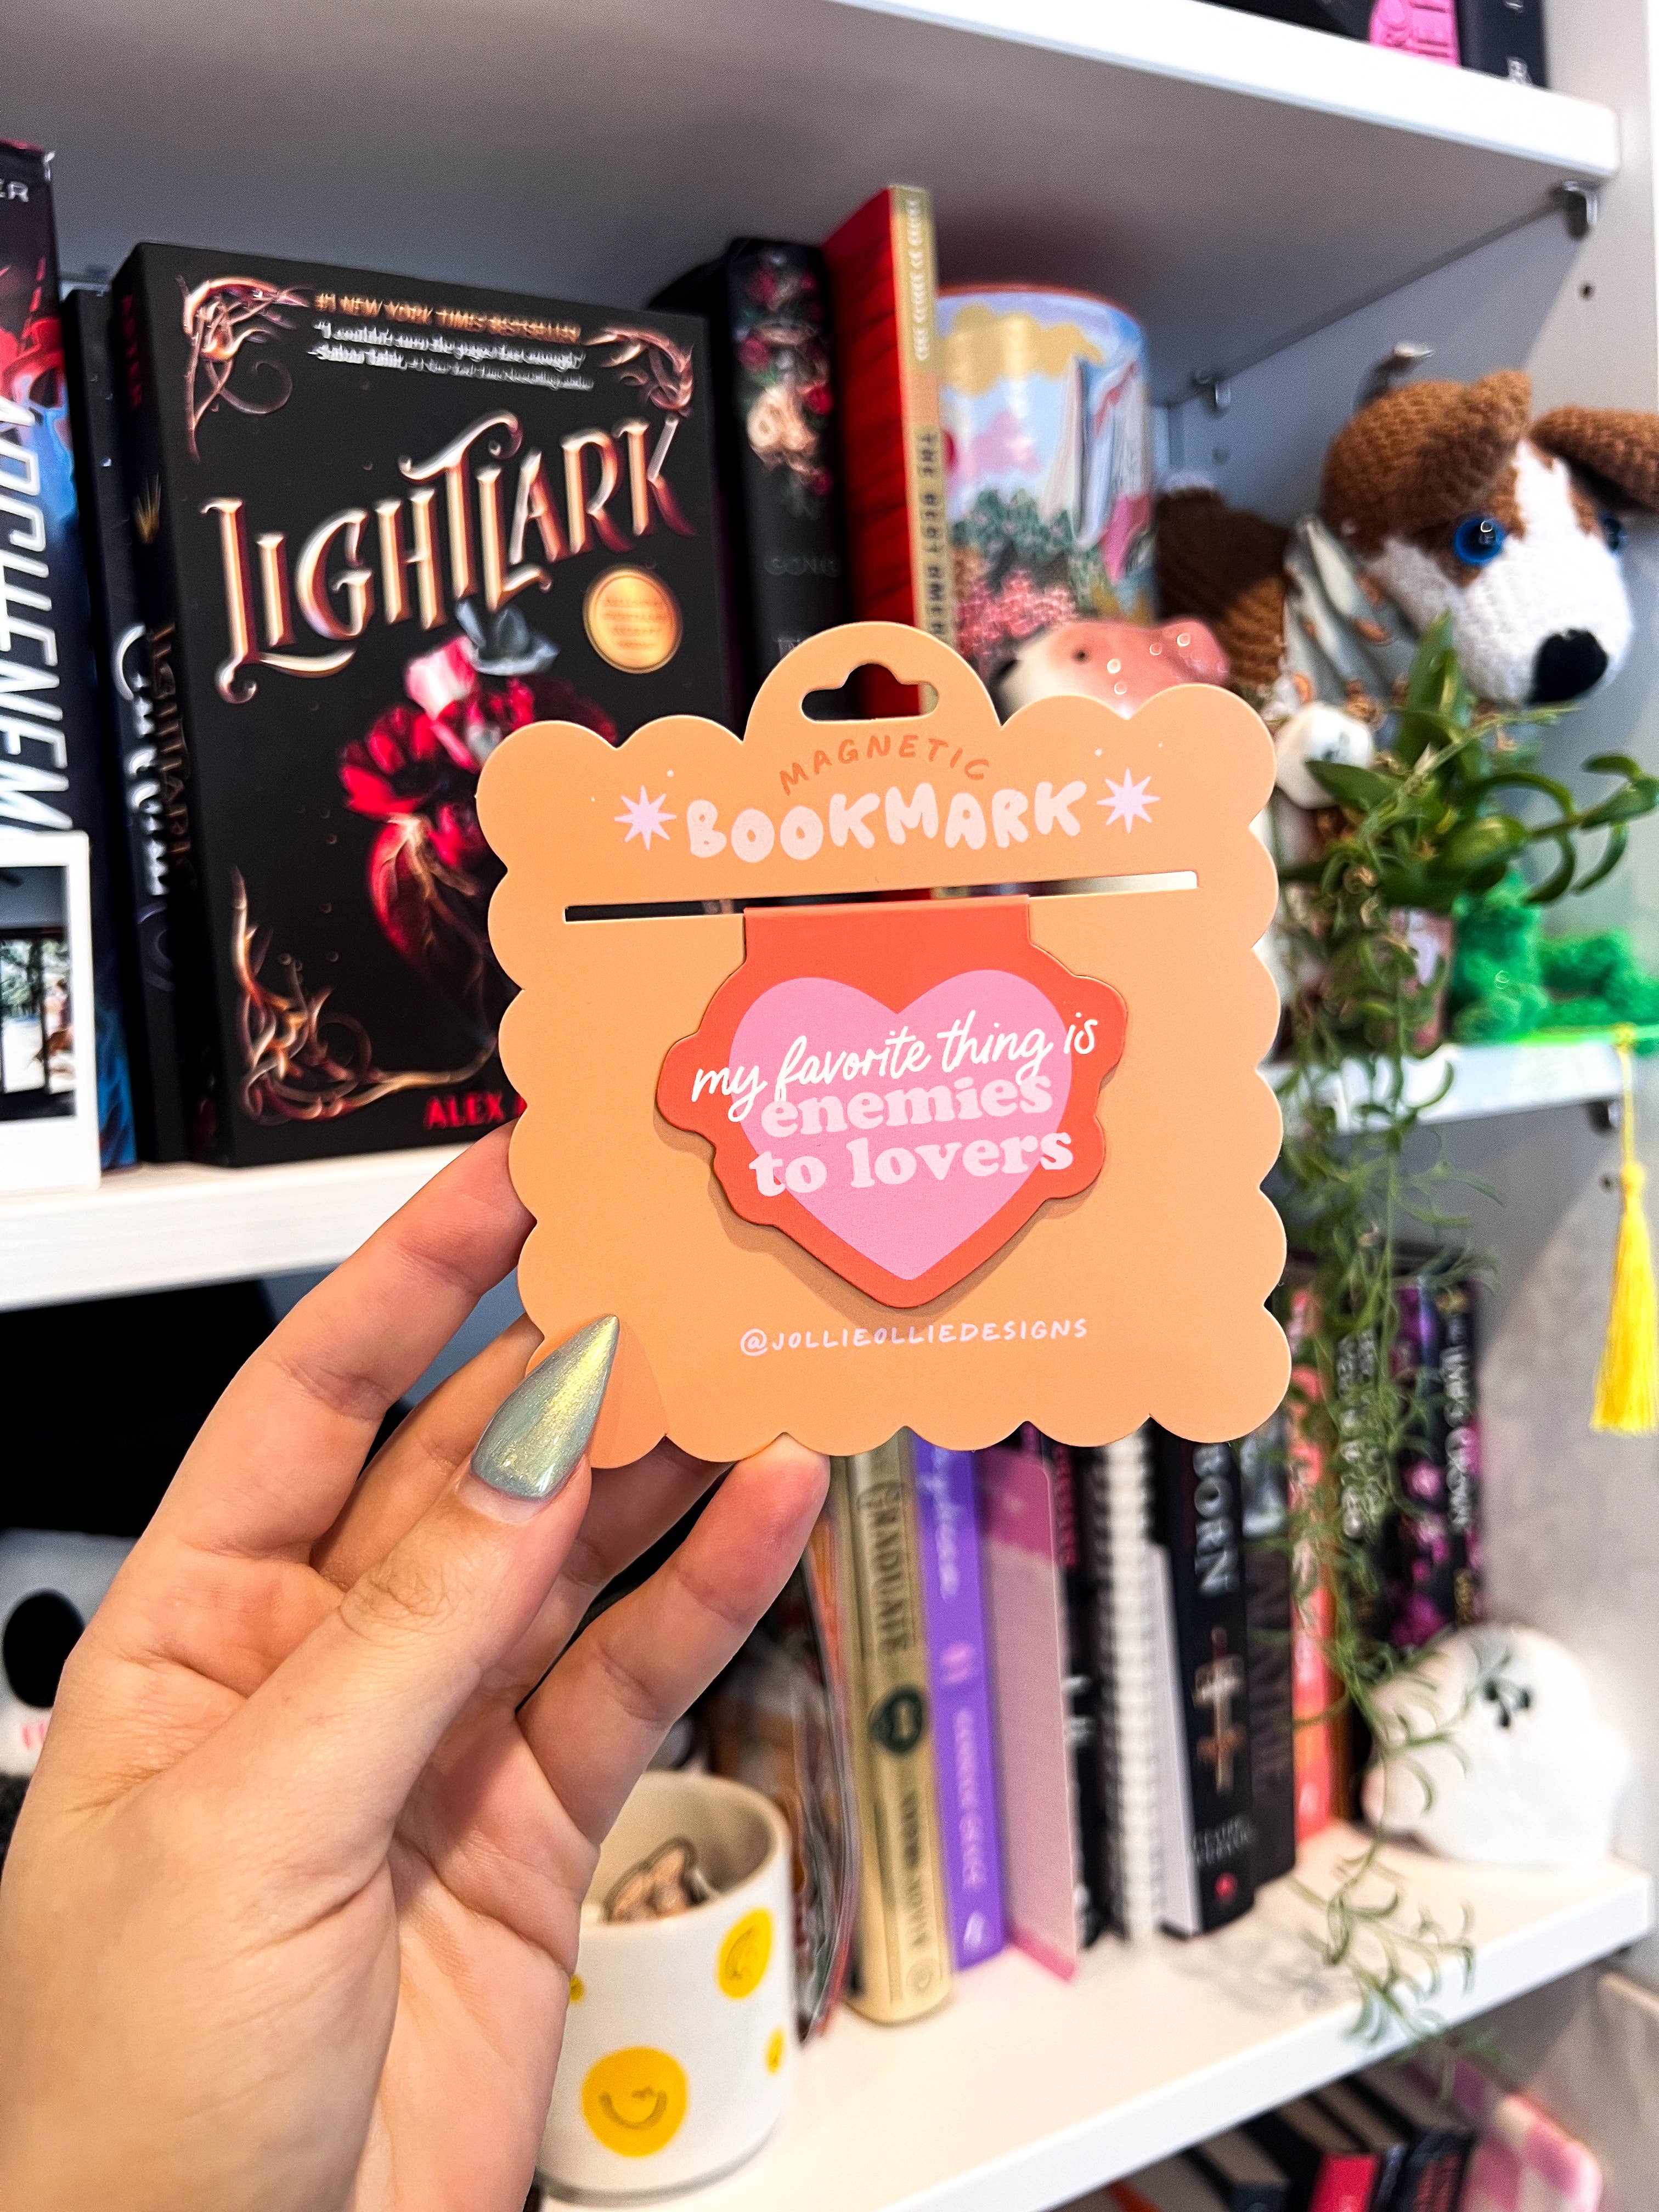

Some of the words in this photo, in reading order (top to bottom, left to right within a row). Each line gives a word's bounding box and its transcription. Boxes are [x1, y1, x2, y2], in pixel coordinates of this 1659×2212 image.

[338, 295, 383, 318] NEW
[384, 301, 433, 325] YORK
[199, 410, 697, 704] LIGHTLARK
[778, 734, 992, 796] MAGNETIC
[686, 781, 1087, 864] BOOKMARK
[691, 1064, 768, 1122] my
[773, 1025, 932, 1102] favorite
[936, 1009, 1054, 1086] thing
[1063, 1012, 1098, 1055] is
[424, 1091, 505, 1129] ALEX
[761, 1075, 1053, 1138] enemies
[748, 1150, 828, 1197] to
[845, 1131, 1074, 1189] lovers
[740, 1318, 1088, 1356] @JOLLIEOLLIEDESIGNS
